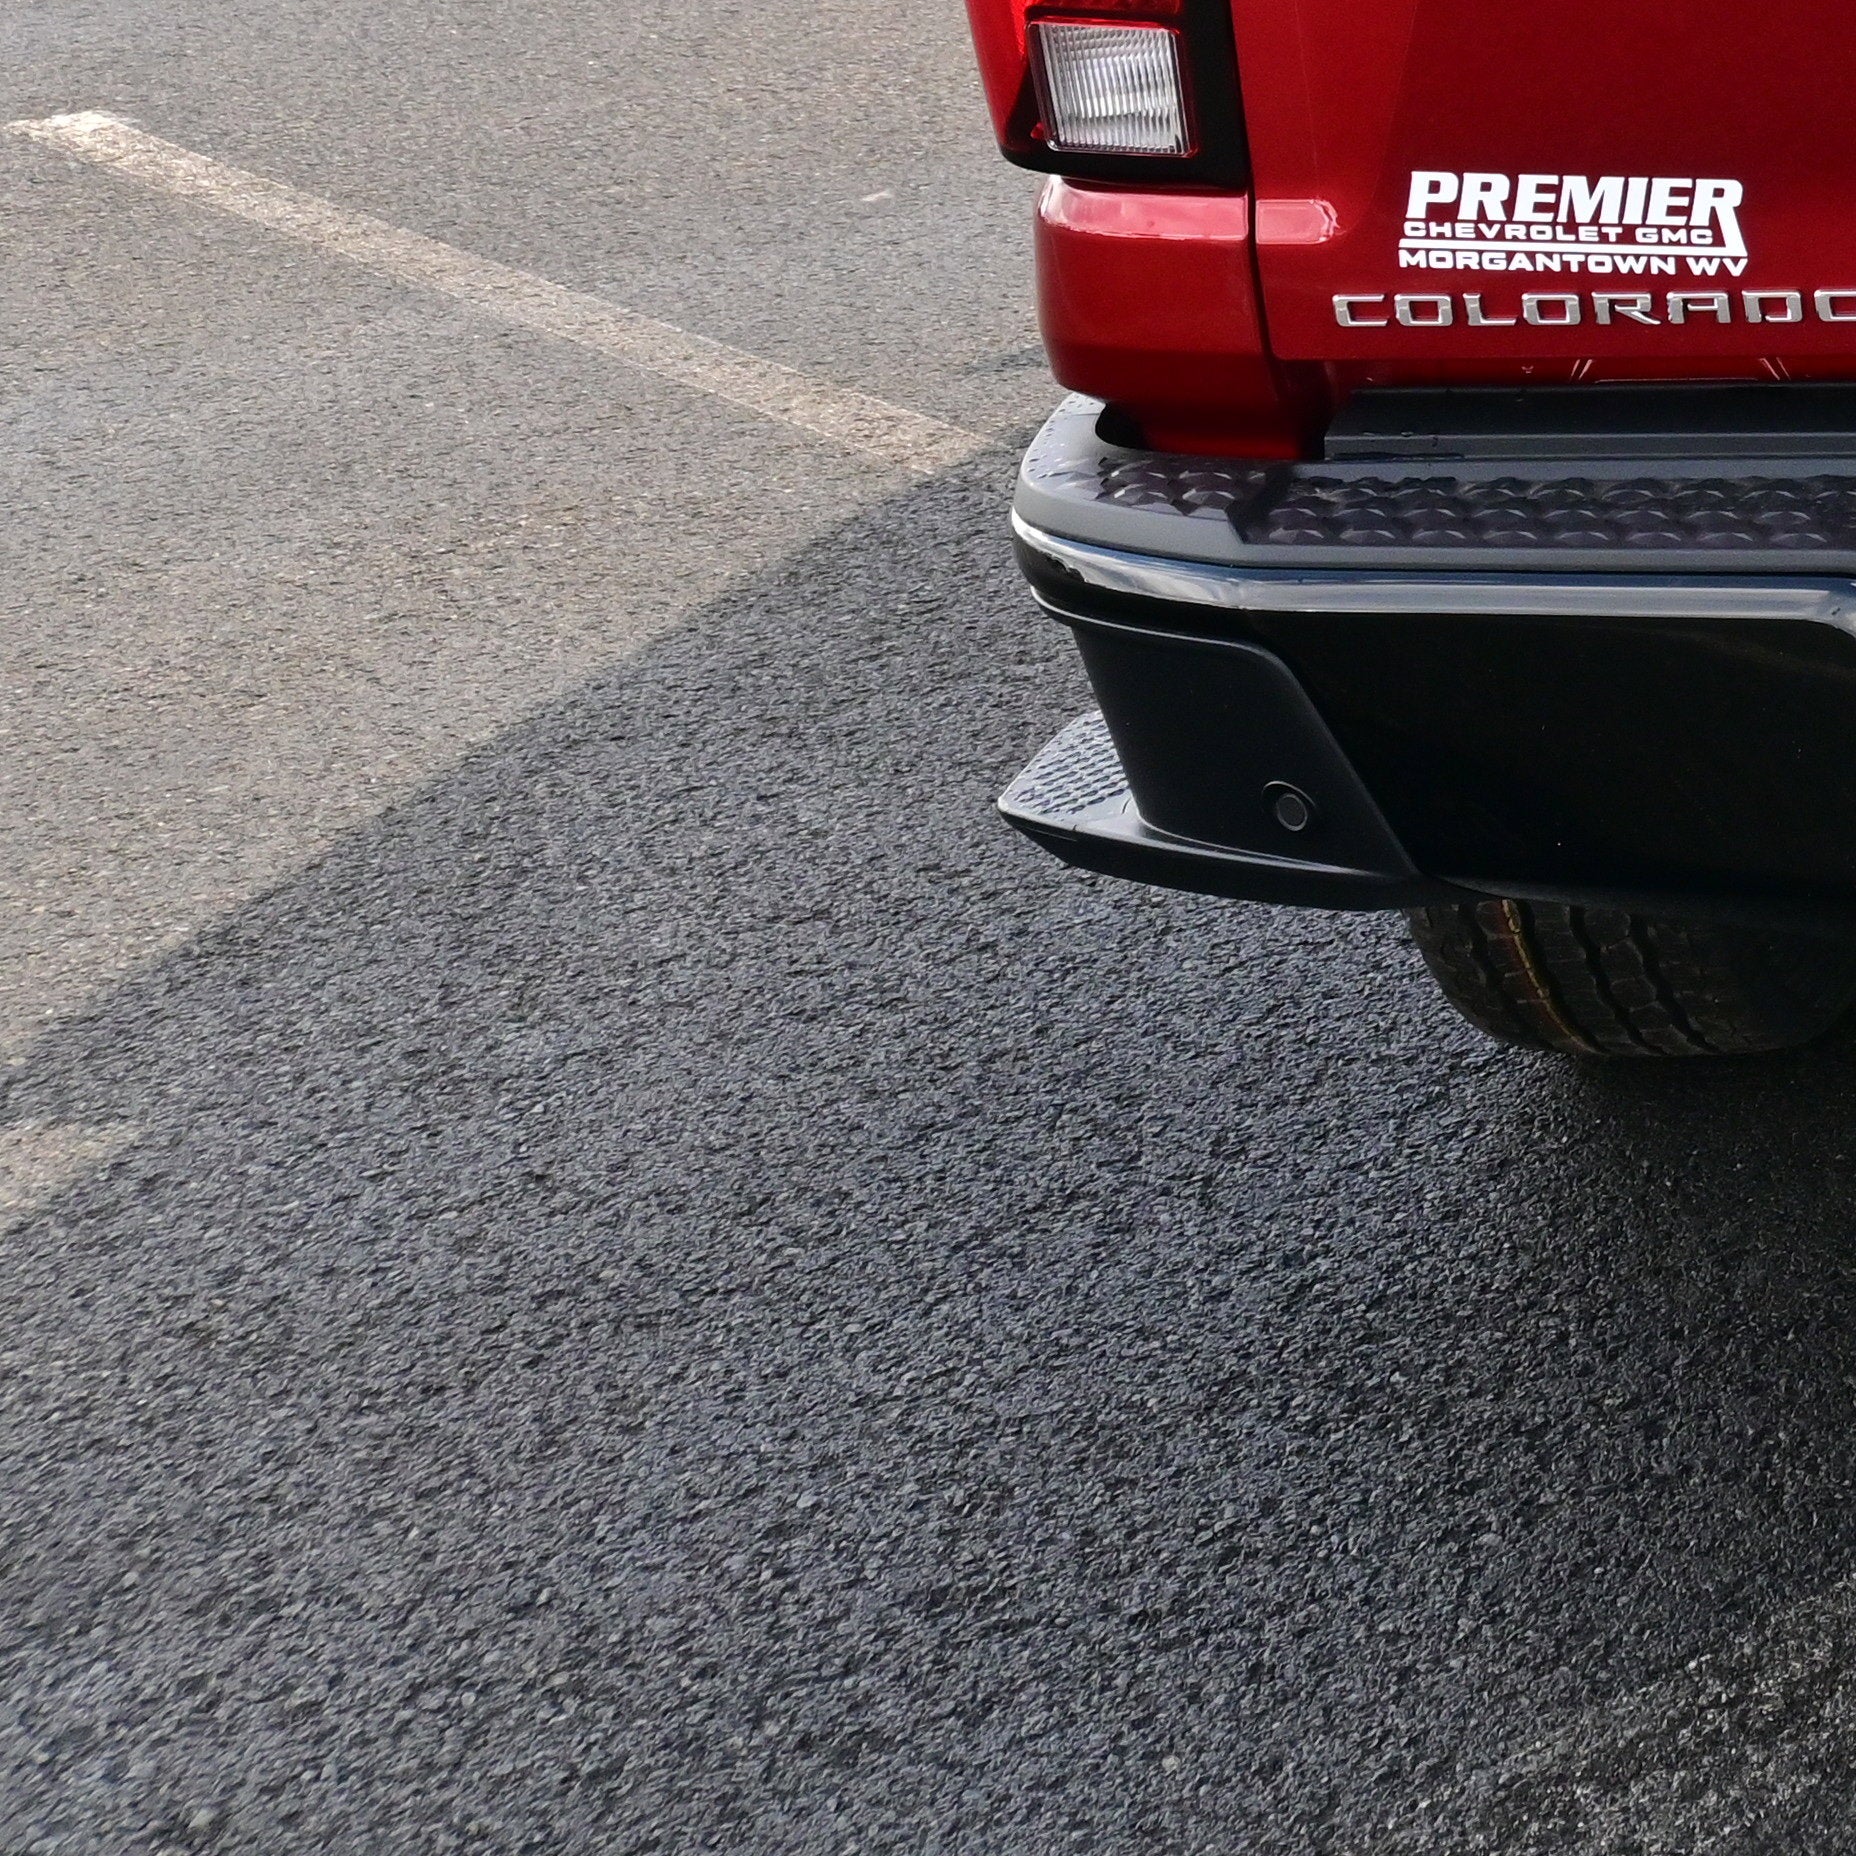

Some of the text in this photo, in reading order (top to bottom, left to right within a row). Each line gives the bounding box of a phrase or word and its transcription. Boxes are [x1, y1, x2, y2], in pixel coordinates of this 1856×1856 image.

[1405, 170, 1745, 228] PREMIER
[1403, 220, 1714, 245] CHEVROLET GMC
[1398, 248, 1748, 277] MORGANTOWN WV
